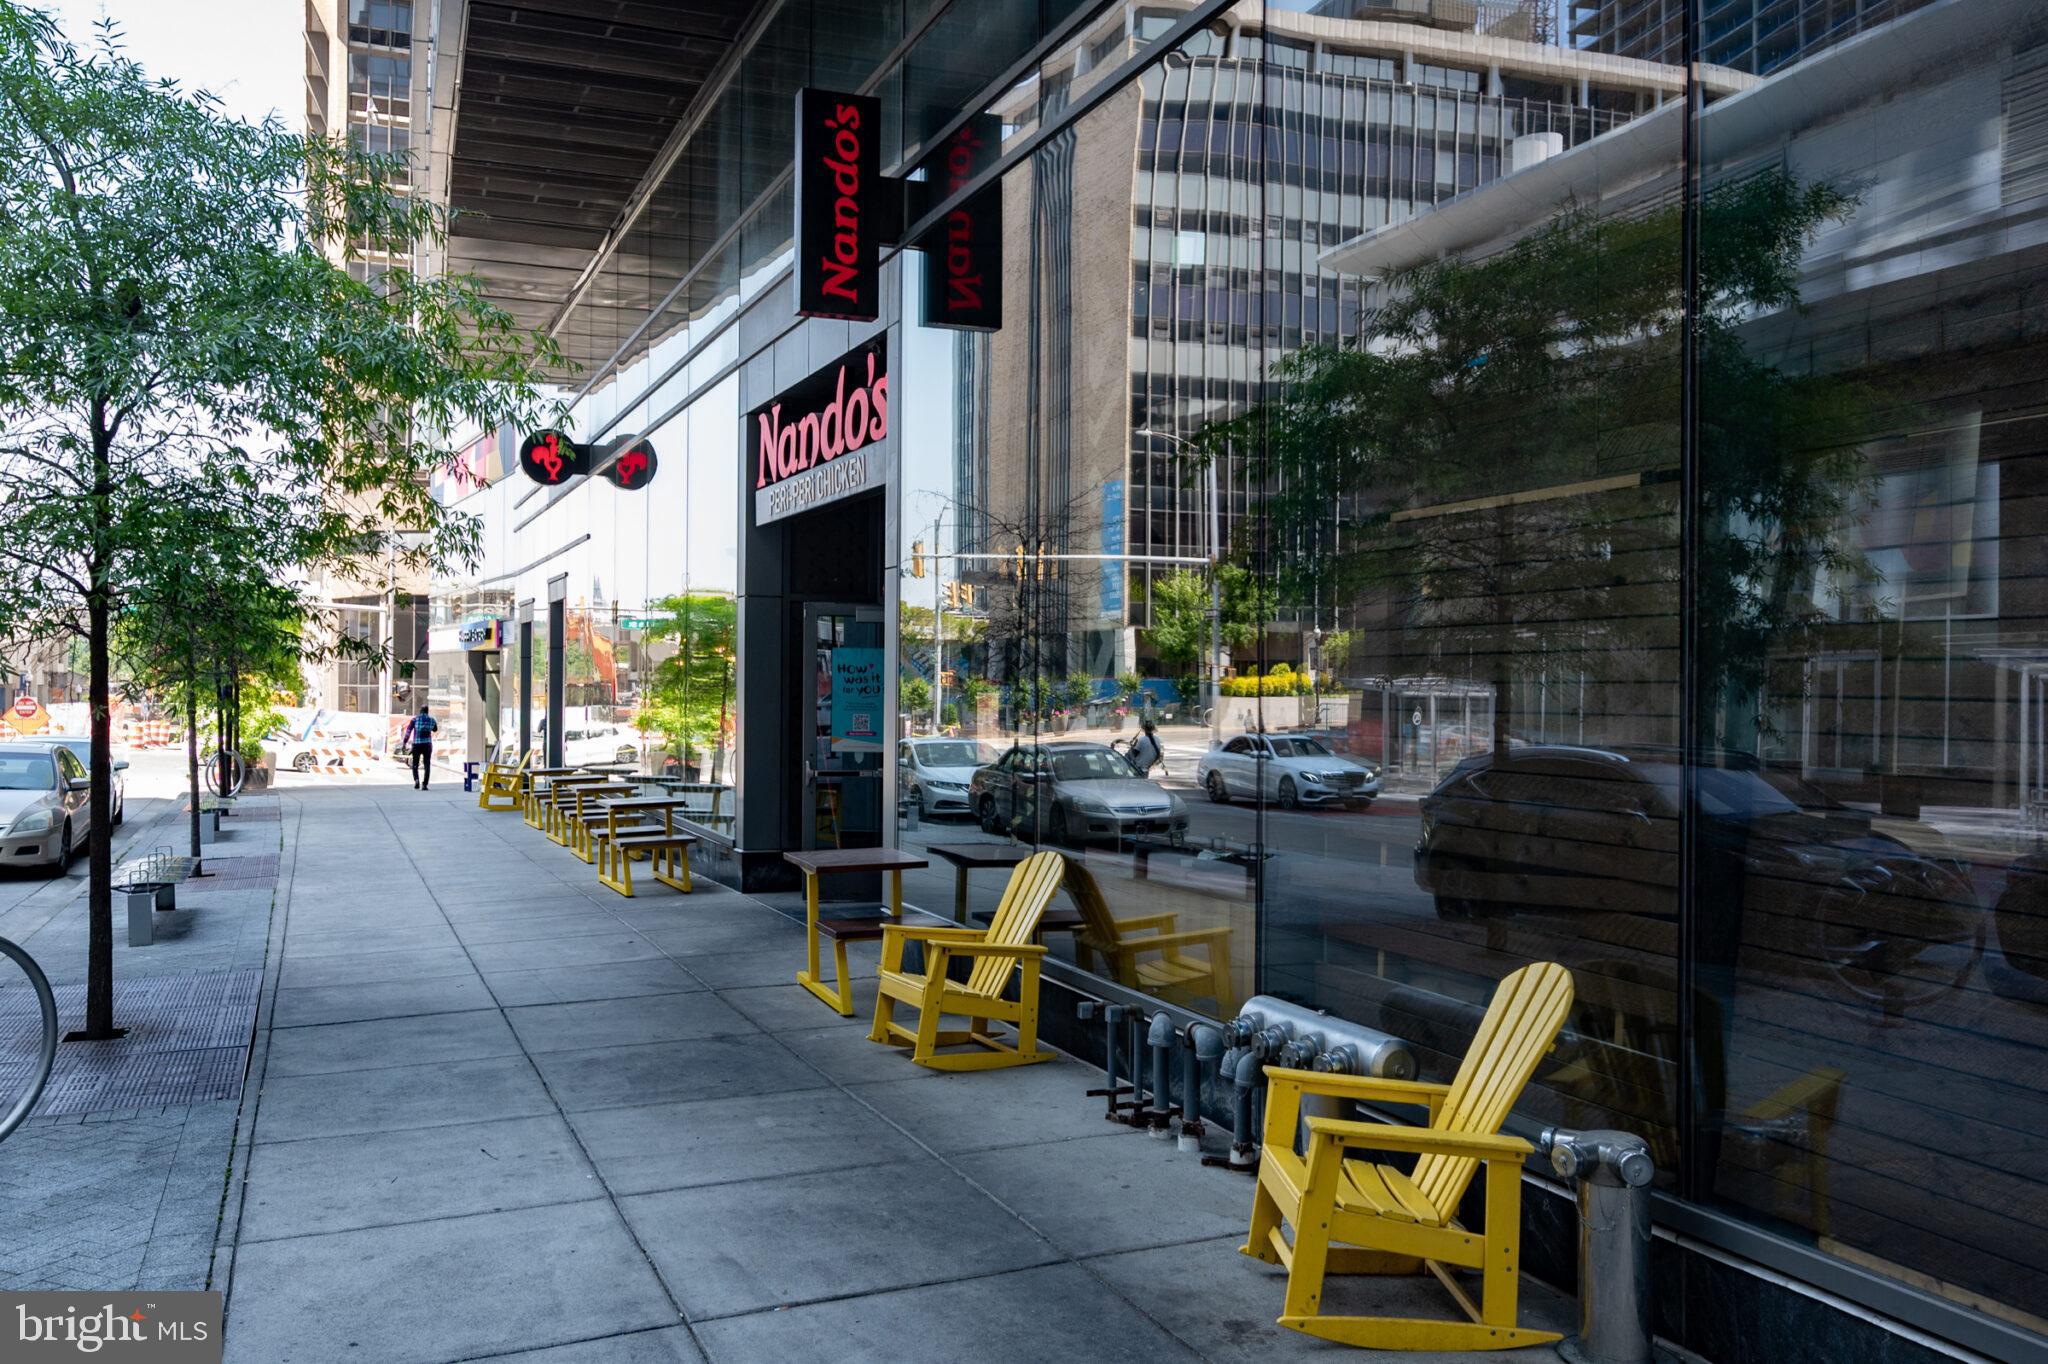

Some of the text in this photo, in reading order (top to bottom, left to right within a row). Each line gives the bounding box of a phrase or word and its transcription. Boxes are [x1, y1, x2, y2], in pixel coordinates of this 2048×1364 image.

[821, 102, 861, 304] Nando's
[757, 352, 887, 489] Nando's
[817, 454, 867, 499] CHICKEN
